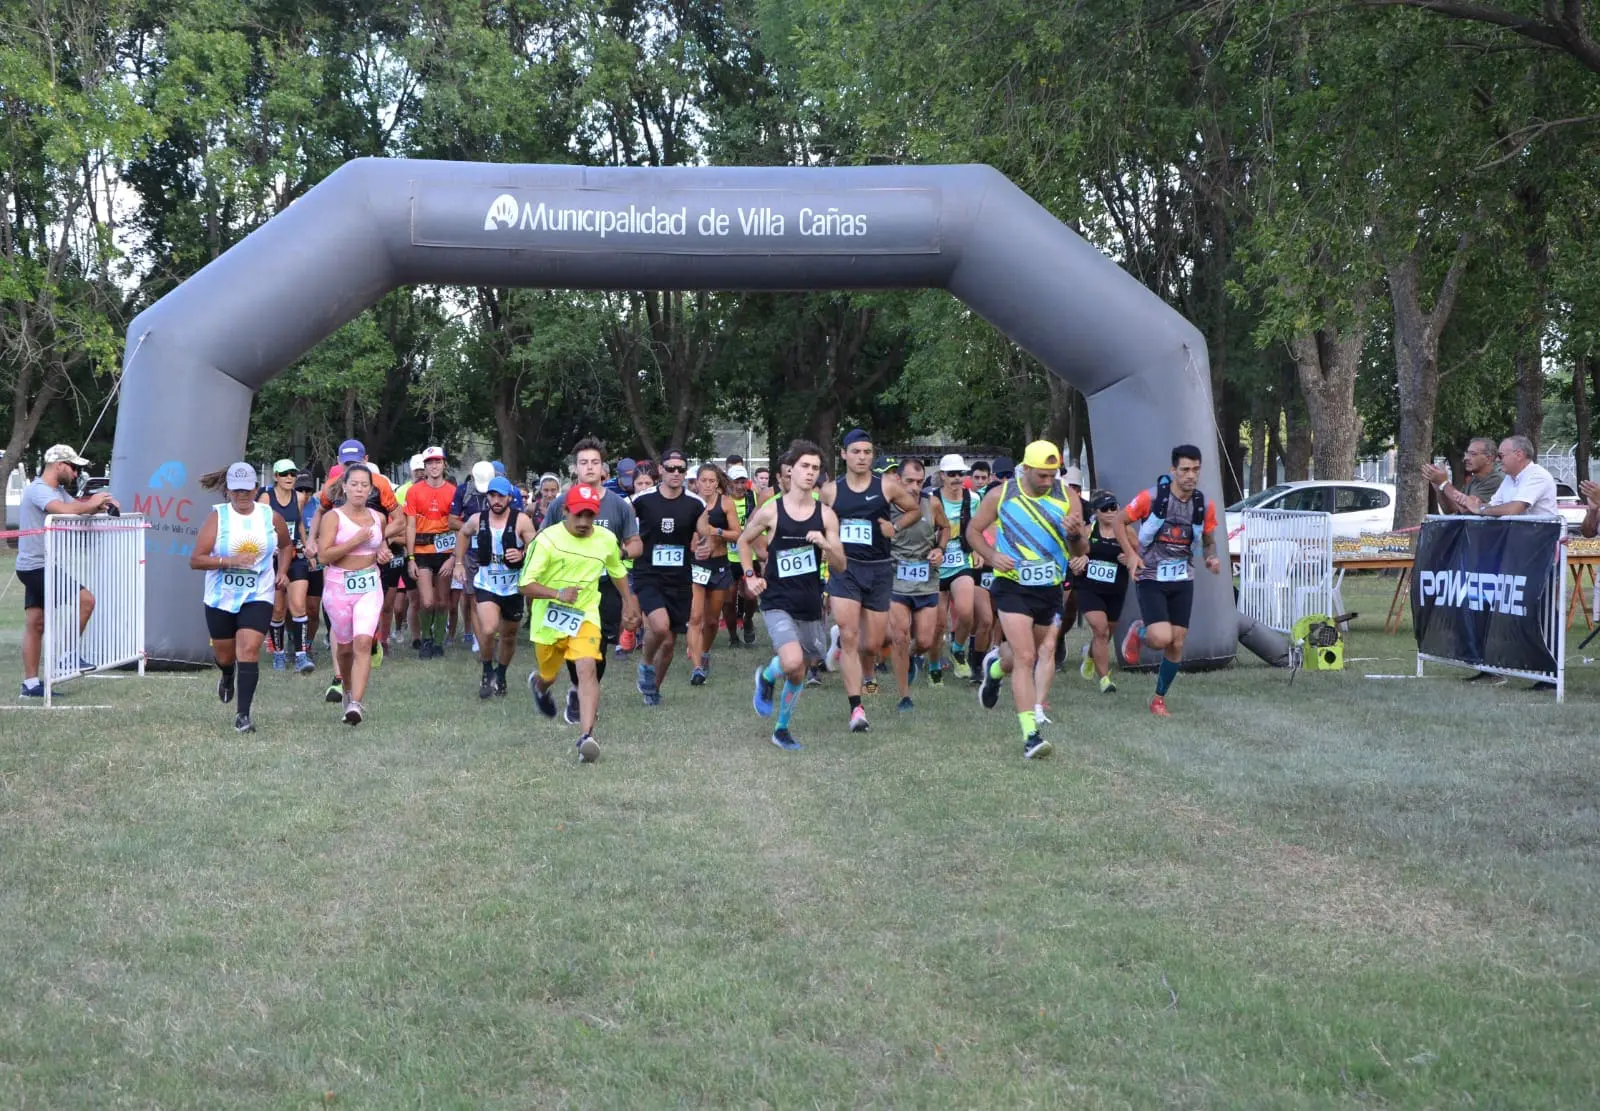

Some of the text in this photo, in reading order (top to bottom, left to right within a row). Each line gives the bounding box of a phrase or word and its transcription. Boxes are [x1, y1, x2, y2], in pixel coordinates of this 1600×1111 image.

[519, 202, 867, 238] Municipalidad de Villa Cañas
[133, 493, 193, 523] MVC
[844, 526, 870, 540] 115
[436, 537, 456, 550] 062
[656, 551, 682, 562] 113
[781, 555, 812, 572] 061
[901, 566, 927, 578] 145
[1021, 565, 1053, 581] 055
[1089, 565, 1114, 579] 008
[1161, 564, 1185, 577] 112
[224, 574, 256, 588] 003
[346, 575, 376, 590] 031
[492, 574, 516, 584] 117
[1419, 569, 1526, 616] POWERADE
[547, 609, 580, 635] 075
